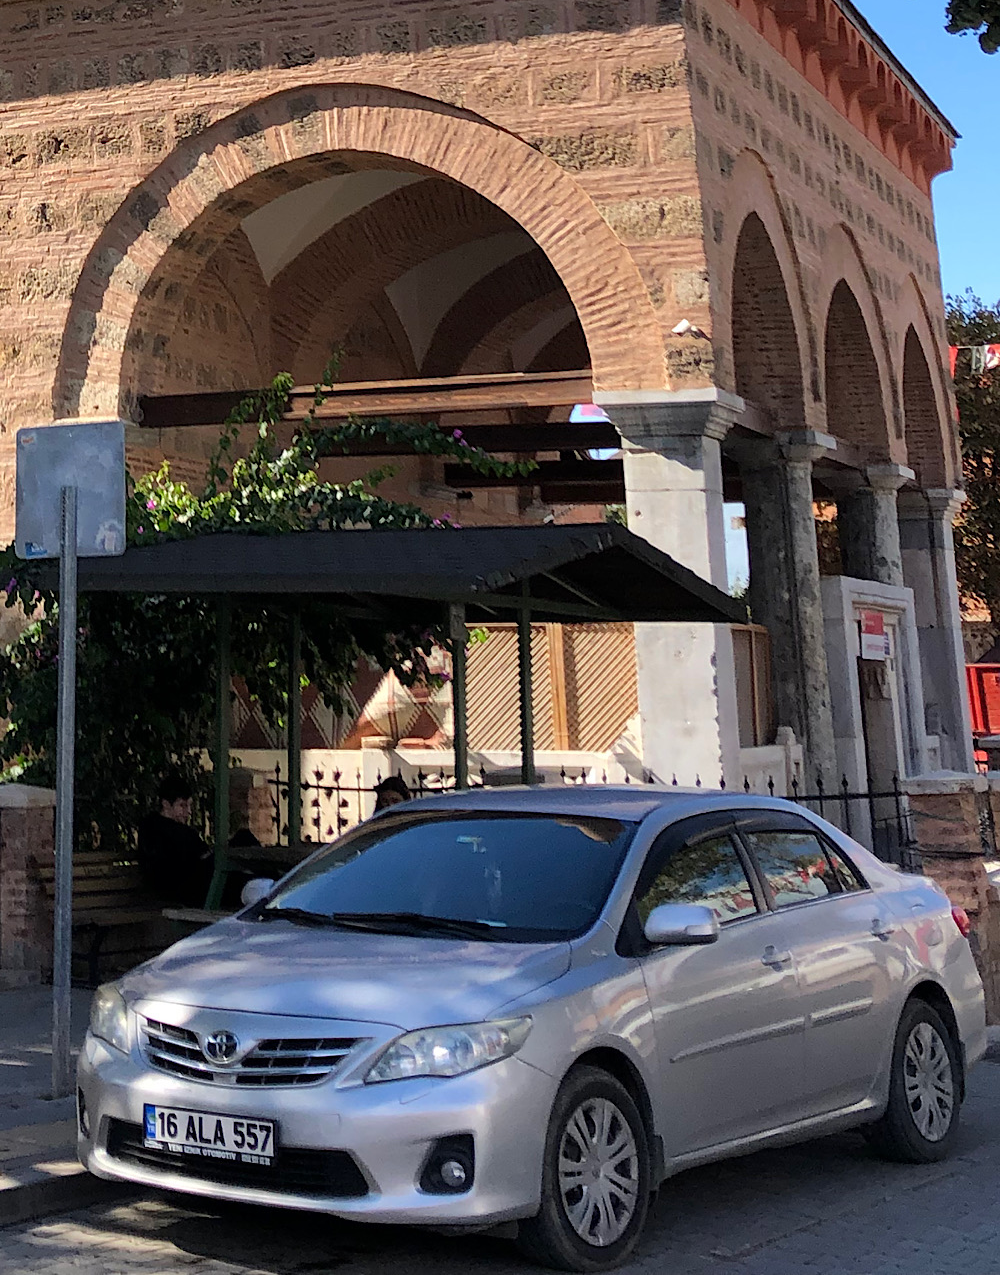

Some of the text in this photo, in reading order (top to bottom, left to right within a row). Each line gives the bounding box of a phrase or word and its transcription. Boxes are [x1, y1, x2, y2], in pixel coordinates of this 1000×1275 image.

[158, 1112, 178, 1138] 16
[185, 1115, 226, 1147] ALA
[233, 1121, 272, 1153] 557
